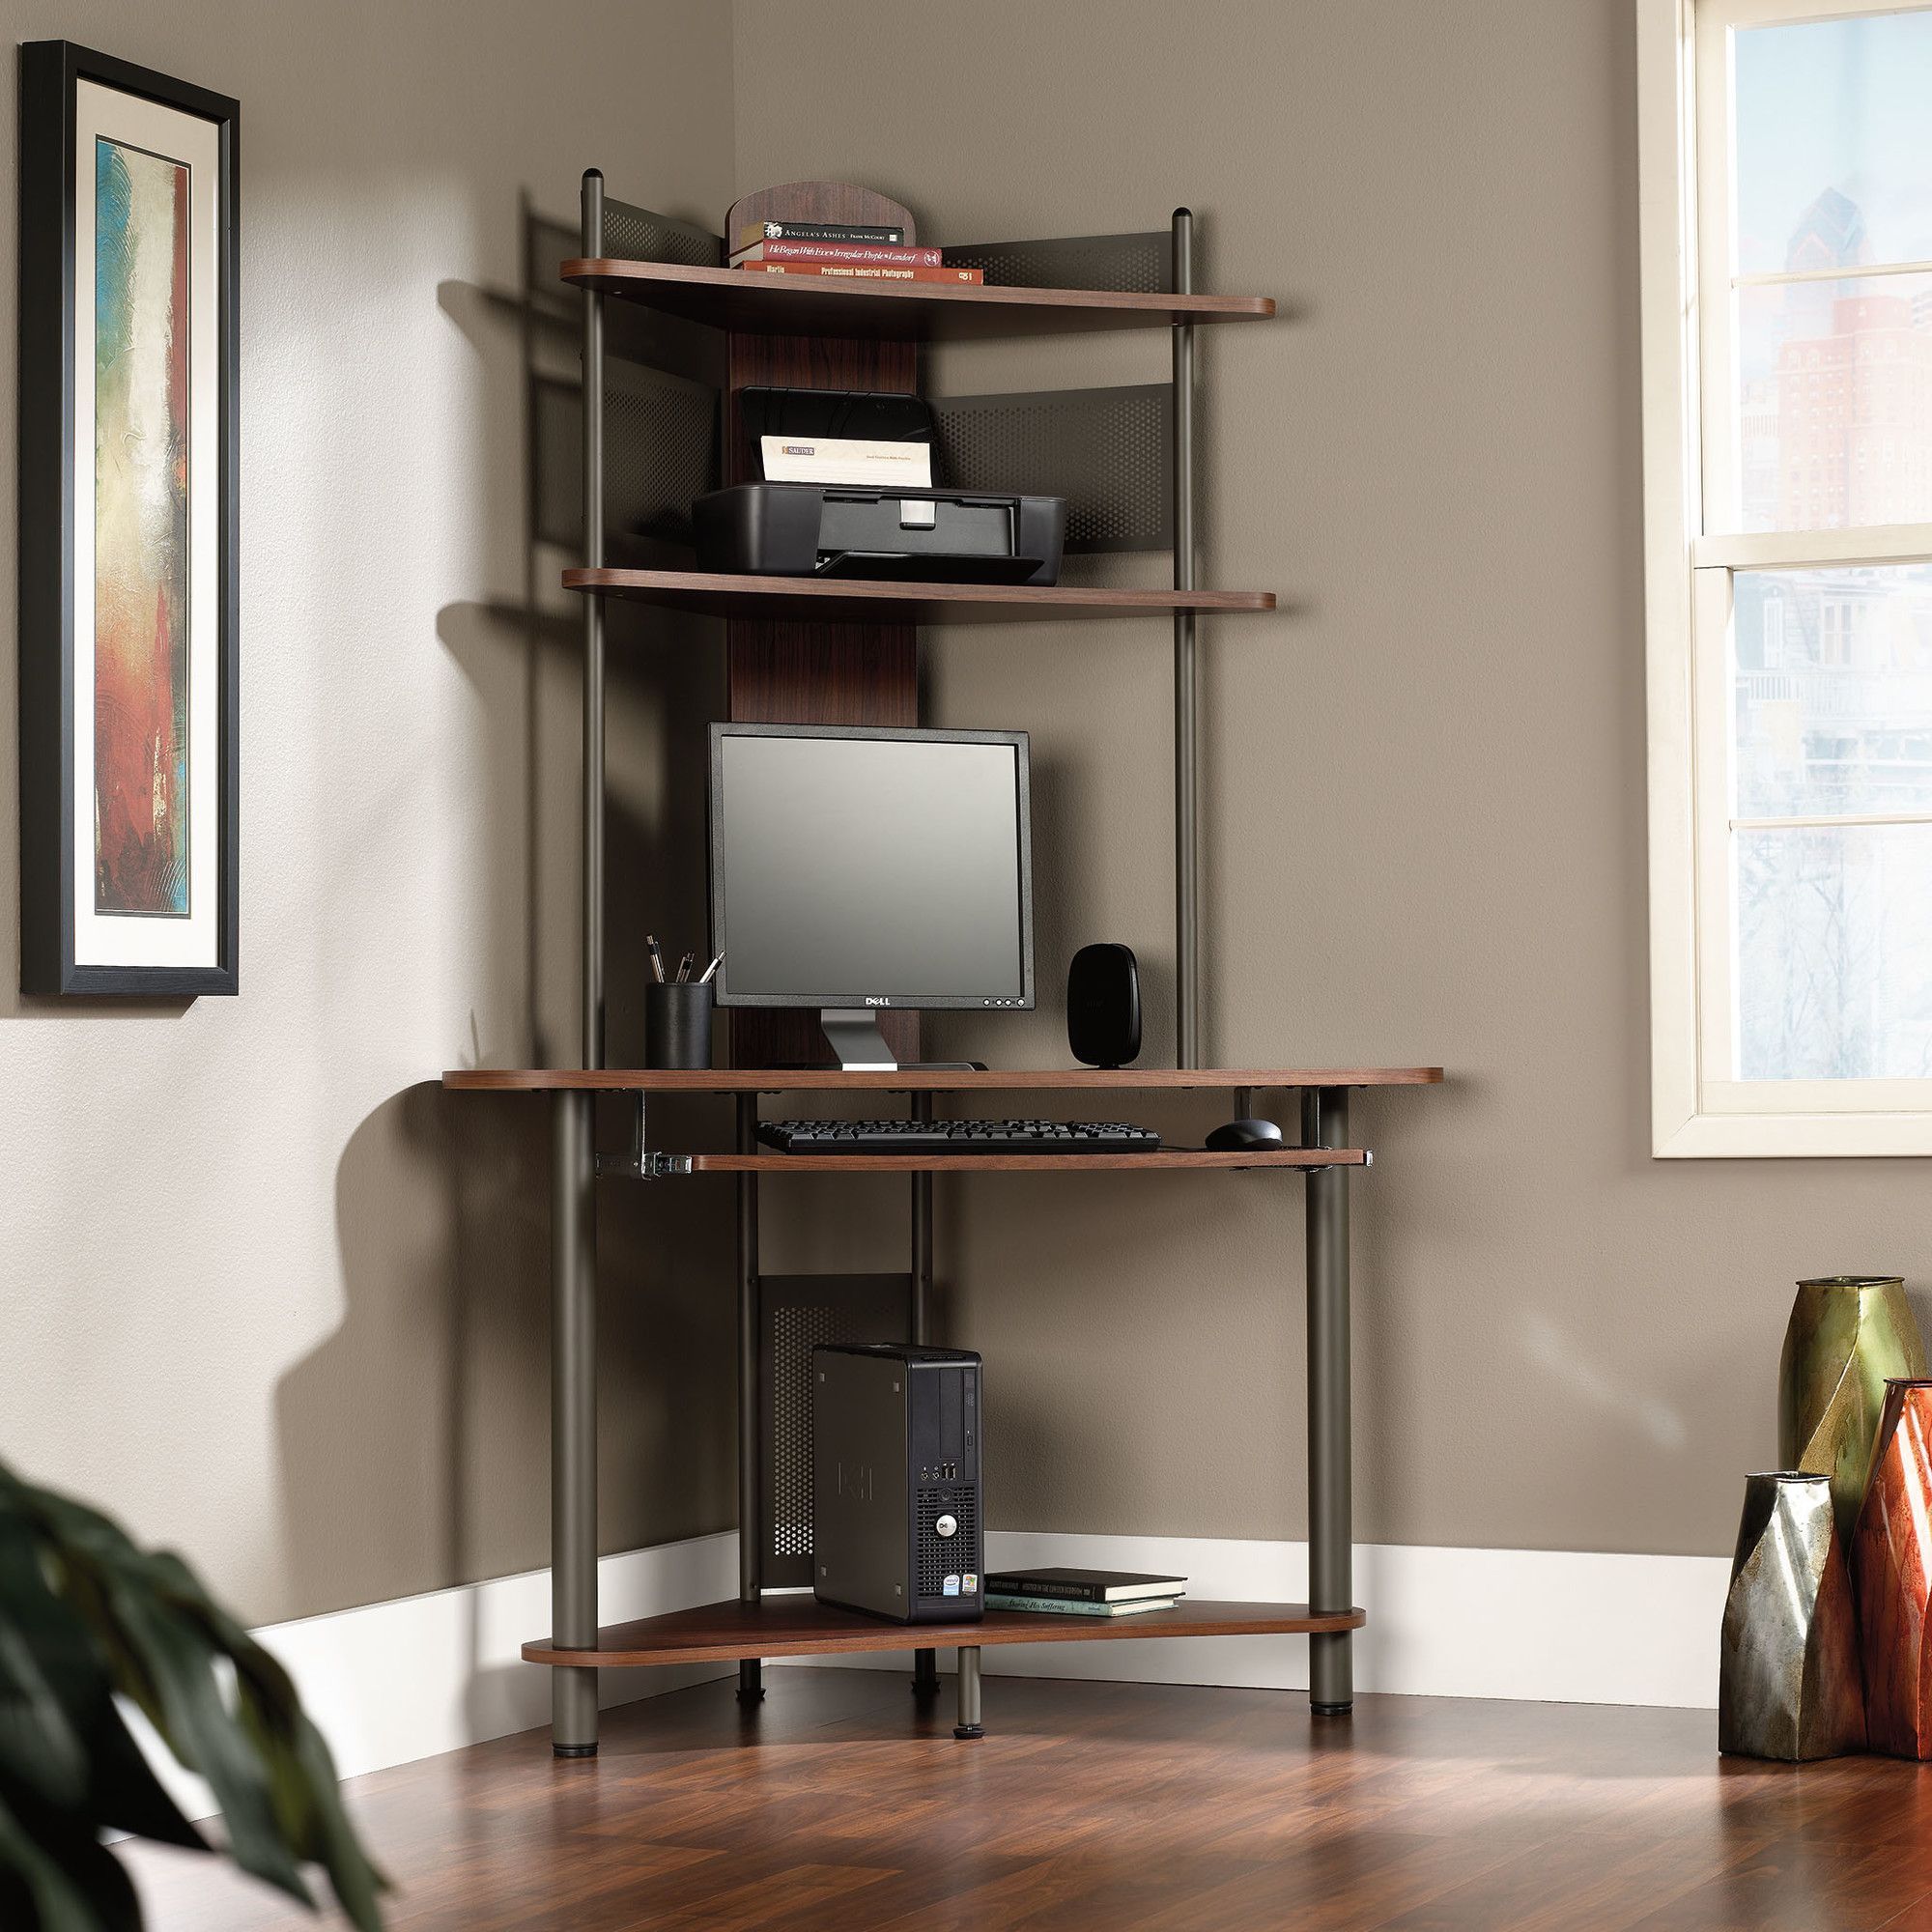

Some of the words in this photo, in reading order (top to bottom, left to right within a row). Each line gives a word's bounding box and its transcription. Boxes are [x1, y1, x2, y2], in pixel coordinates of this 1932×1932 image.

[784, 229, 820, 238] ANGELA'S
[821, 267, 854, 276] Professional
[855, 268, 881, 278] Industrial
[881, 269, 914, 279] Photography
[866, 997, 891, 1006] DELL
[1040, 1602, 1065, 1611] Suffering
